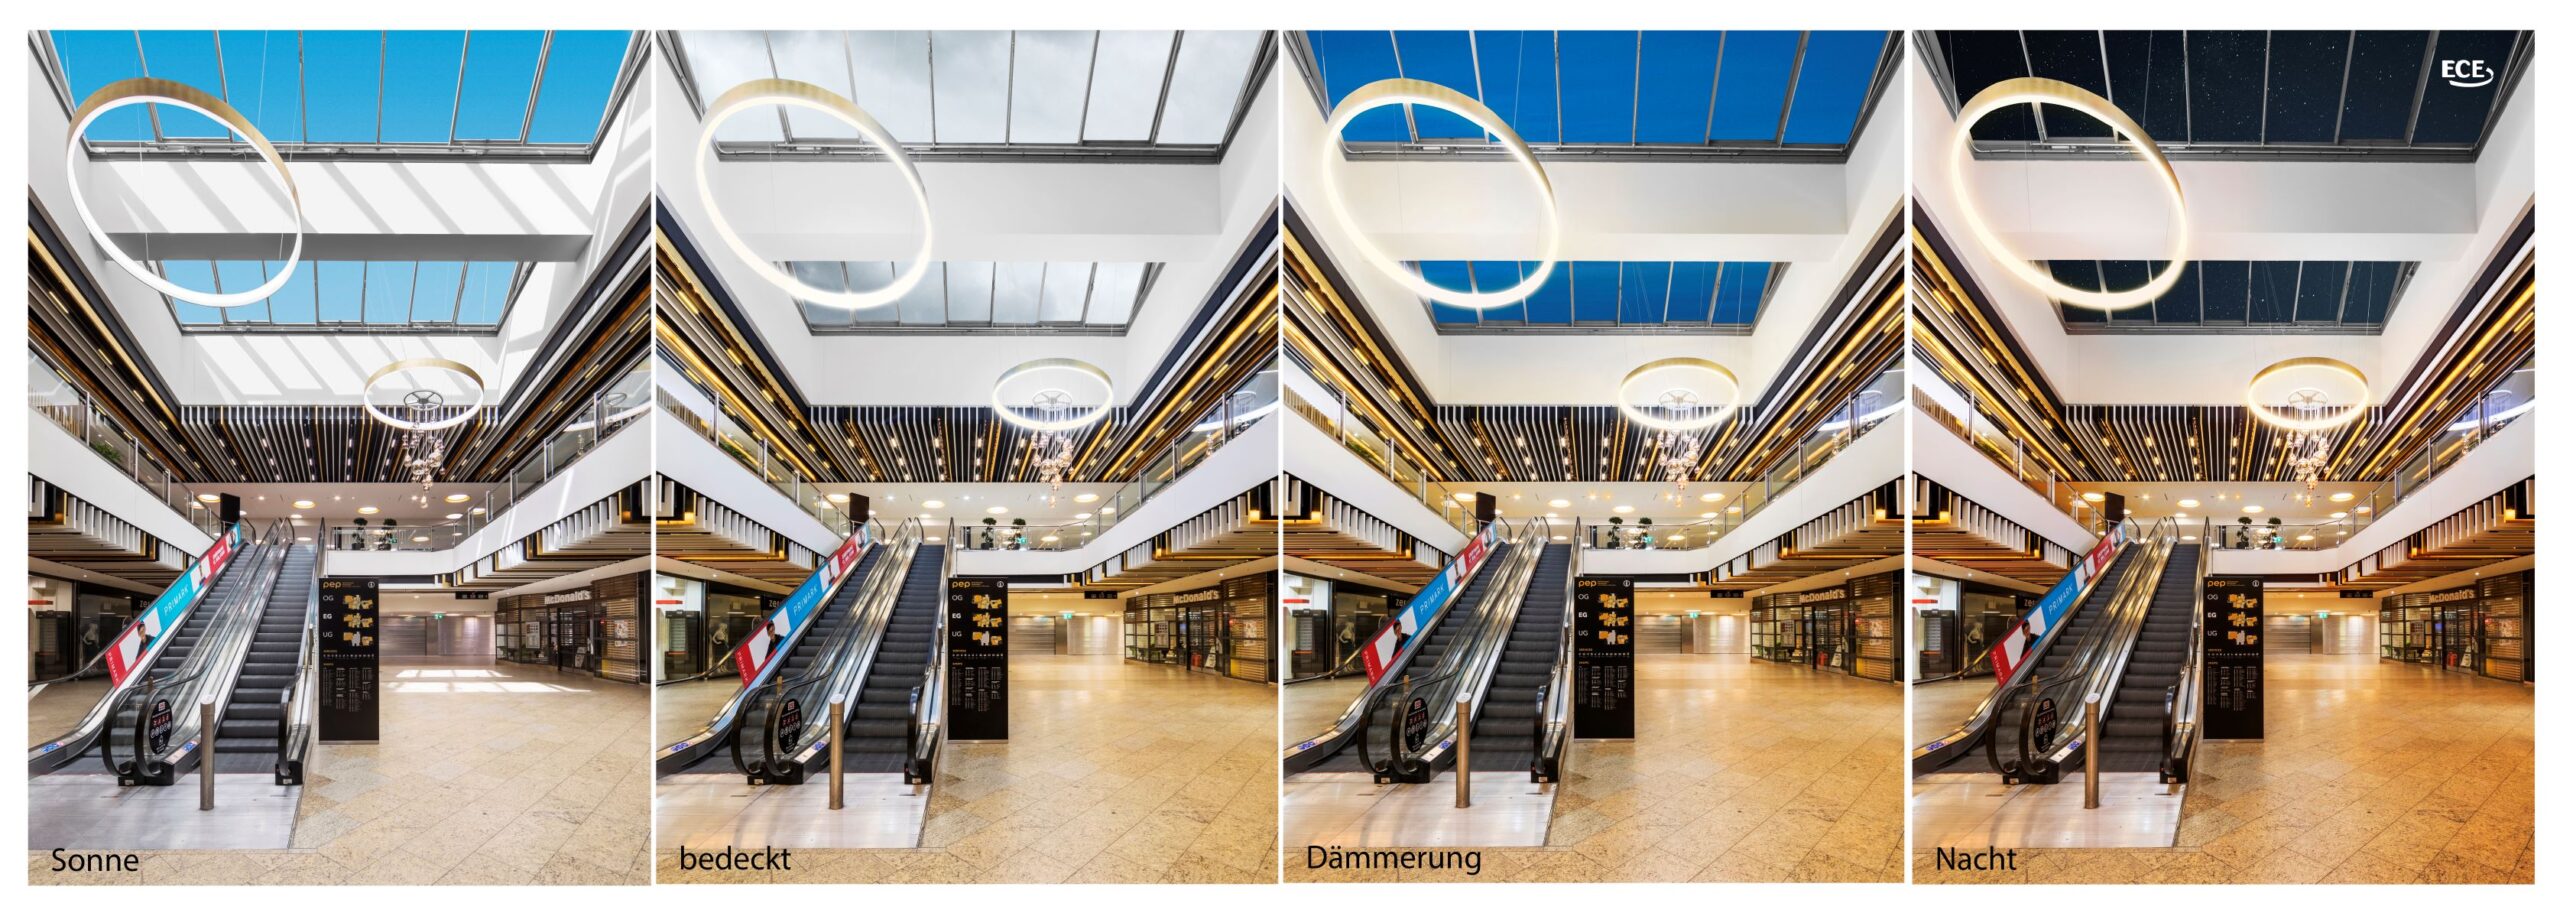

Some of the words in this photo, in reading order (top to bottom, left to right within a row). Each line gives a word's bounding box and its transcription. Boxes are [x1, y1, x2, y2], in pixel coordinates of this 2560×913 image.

[323, 581, 341, 589] pep
[952, 581, 970, 589] pep
[1578, 580, 1597, 588] pep
[2207, 580, 2226, 588] pep
[164, 583, 189, 615] PRIMARK
[544, 590, 591, 605] McDonald's
[793, 583, 818, 616] PRIMARK
[1173, 590, 1219, 605] McDonald's
[1419, 583, 1444, 615] PRIMARK
[1799, 589, 1845, 604] McDonald's
[2048, 583, 2074, 615] PRIMARK
[2428, 589, 2474, 604] McDonald's
